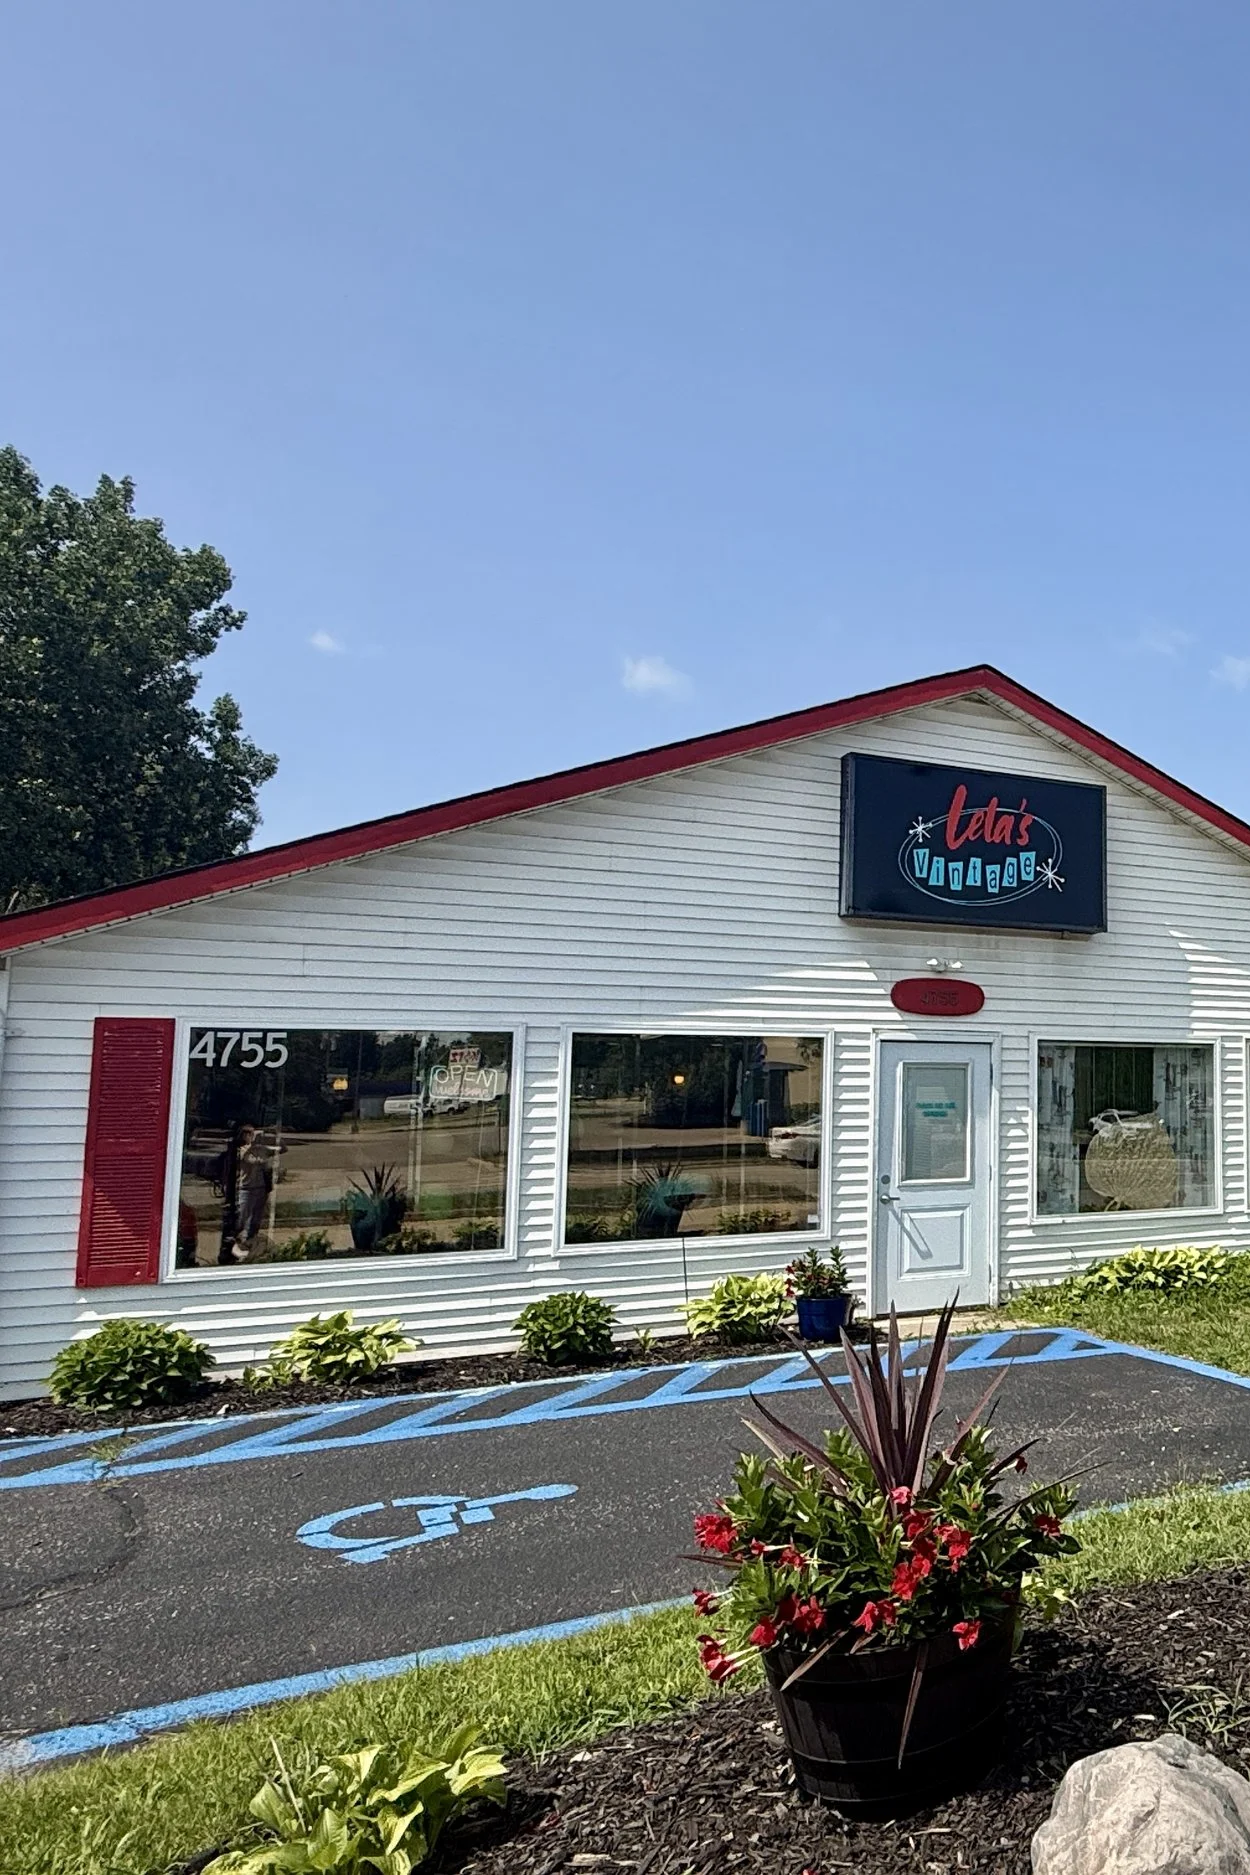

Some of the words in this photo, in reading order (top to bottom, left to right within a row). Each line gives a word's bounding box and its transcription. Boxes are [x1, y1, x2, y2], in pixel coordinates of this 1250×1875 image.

[944, 783, 1034, 850] Lela's
[914, 850, 1035, 891] Vintage
[189, 1031, 288, 1068] 4755
[436, 1065, 494, 1087] OPEN
